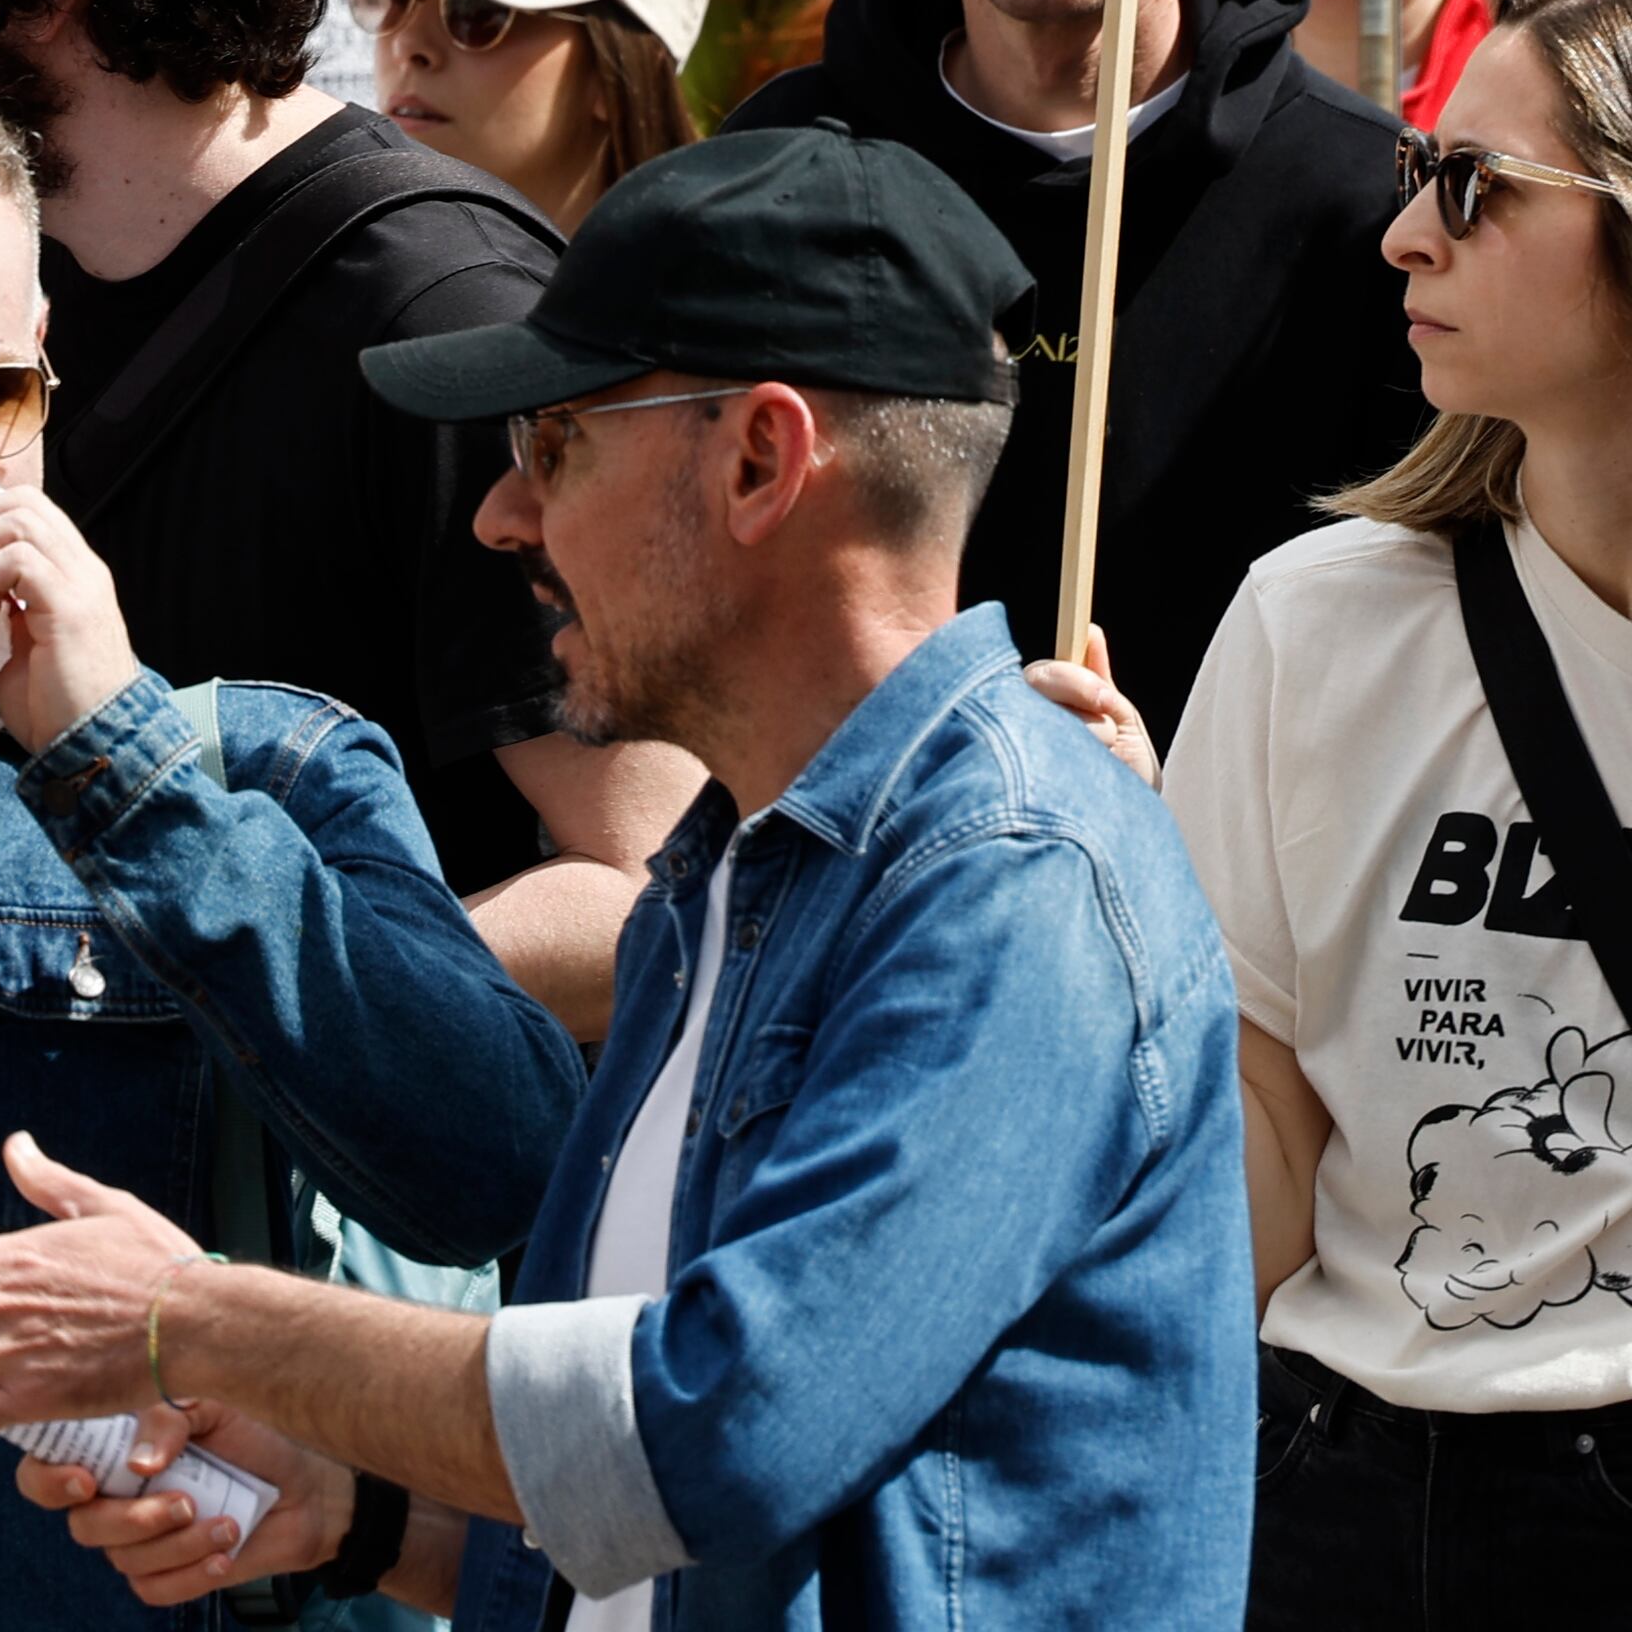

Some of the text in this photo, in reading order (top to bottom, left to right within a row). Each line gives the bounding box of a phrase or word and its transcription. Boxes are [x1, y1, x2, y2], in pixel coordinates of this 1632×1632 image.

[1403, 978, 1488, 1003] VIVIR
[1418, 1009, 1506, 1038] PARA
[1395, 1037, 1486, 1070] VIVIR,
